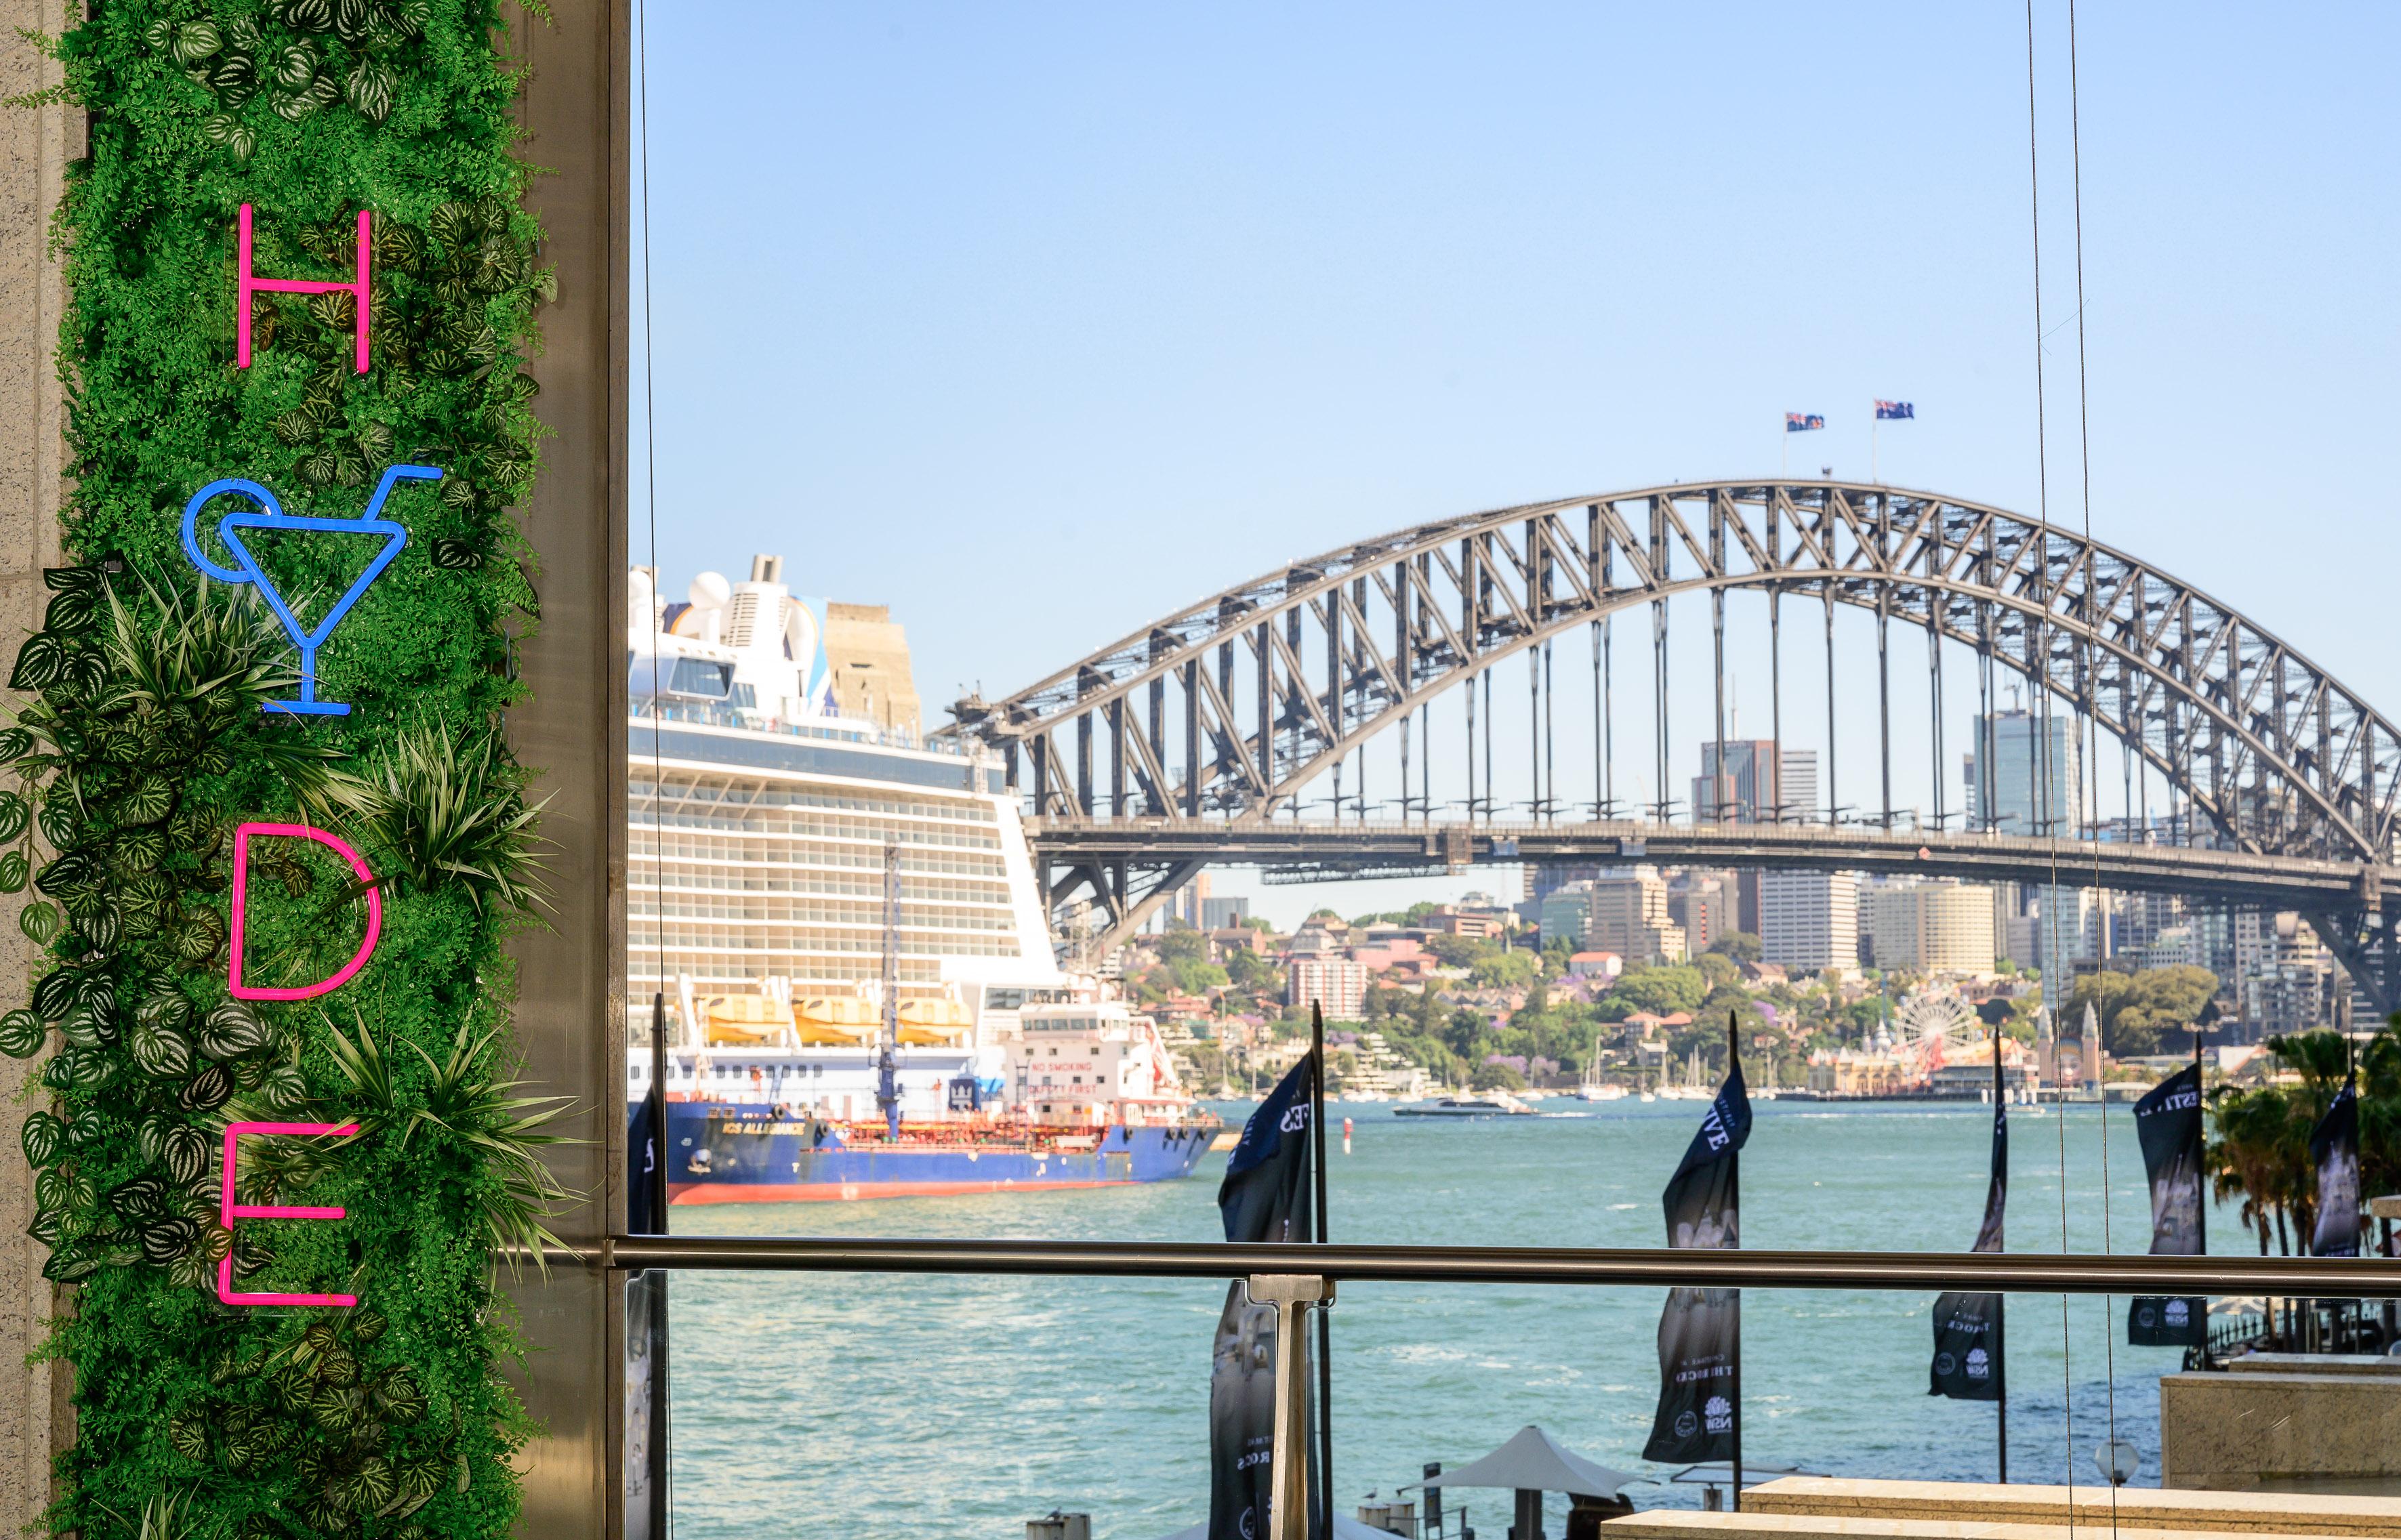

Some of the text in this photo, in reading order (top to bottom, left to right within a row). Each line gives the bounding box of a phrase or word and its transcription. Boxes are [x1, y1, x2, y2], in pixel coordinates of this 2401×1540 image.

[1032, 1062, 1092, 1070] NO SMOKING
[1069, 1084, 1096, 1093] FIRST
[722, 1122, 743, 1134] ICS
